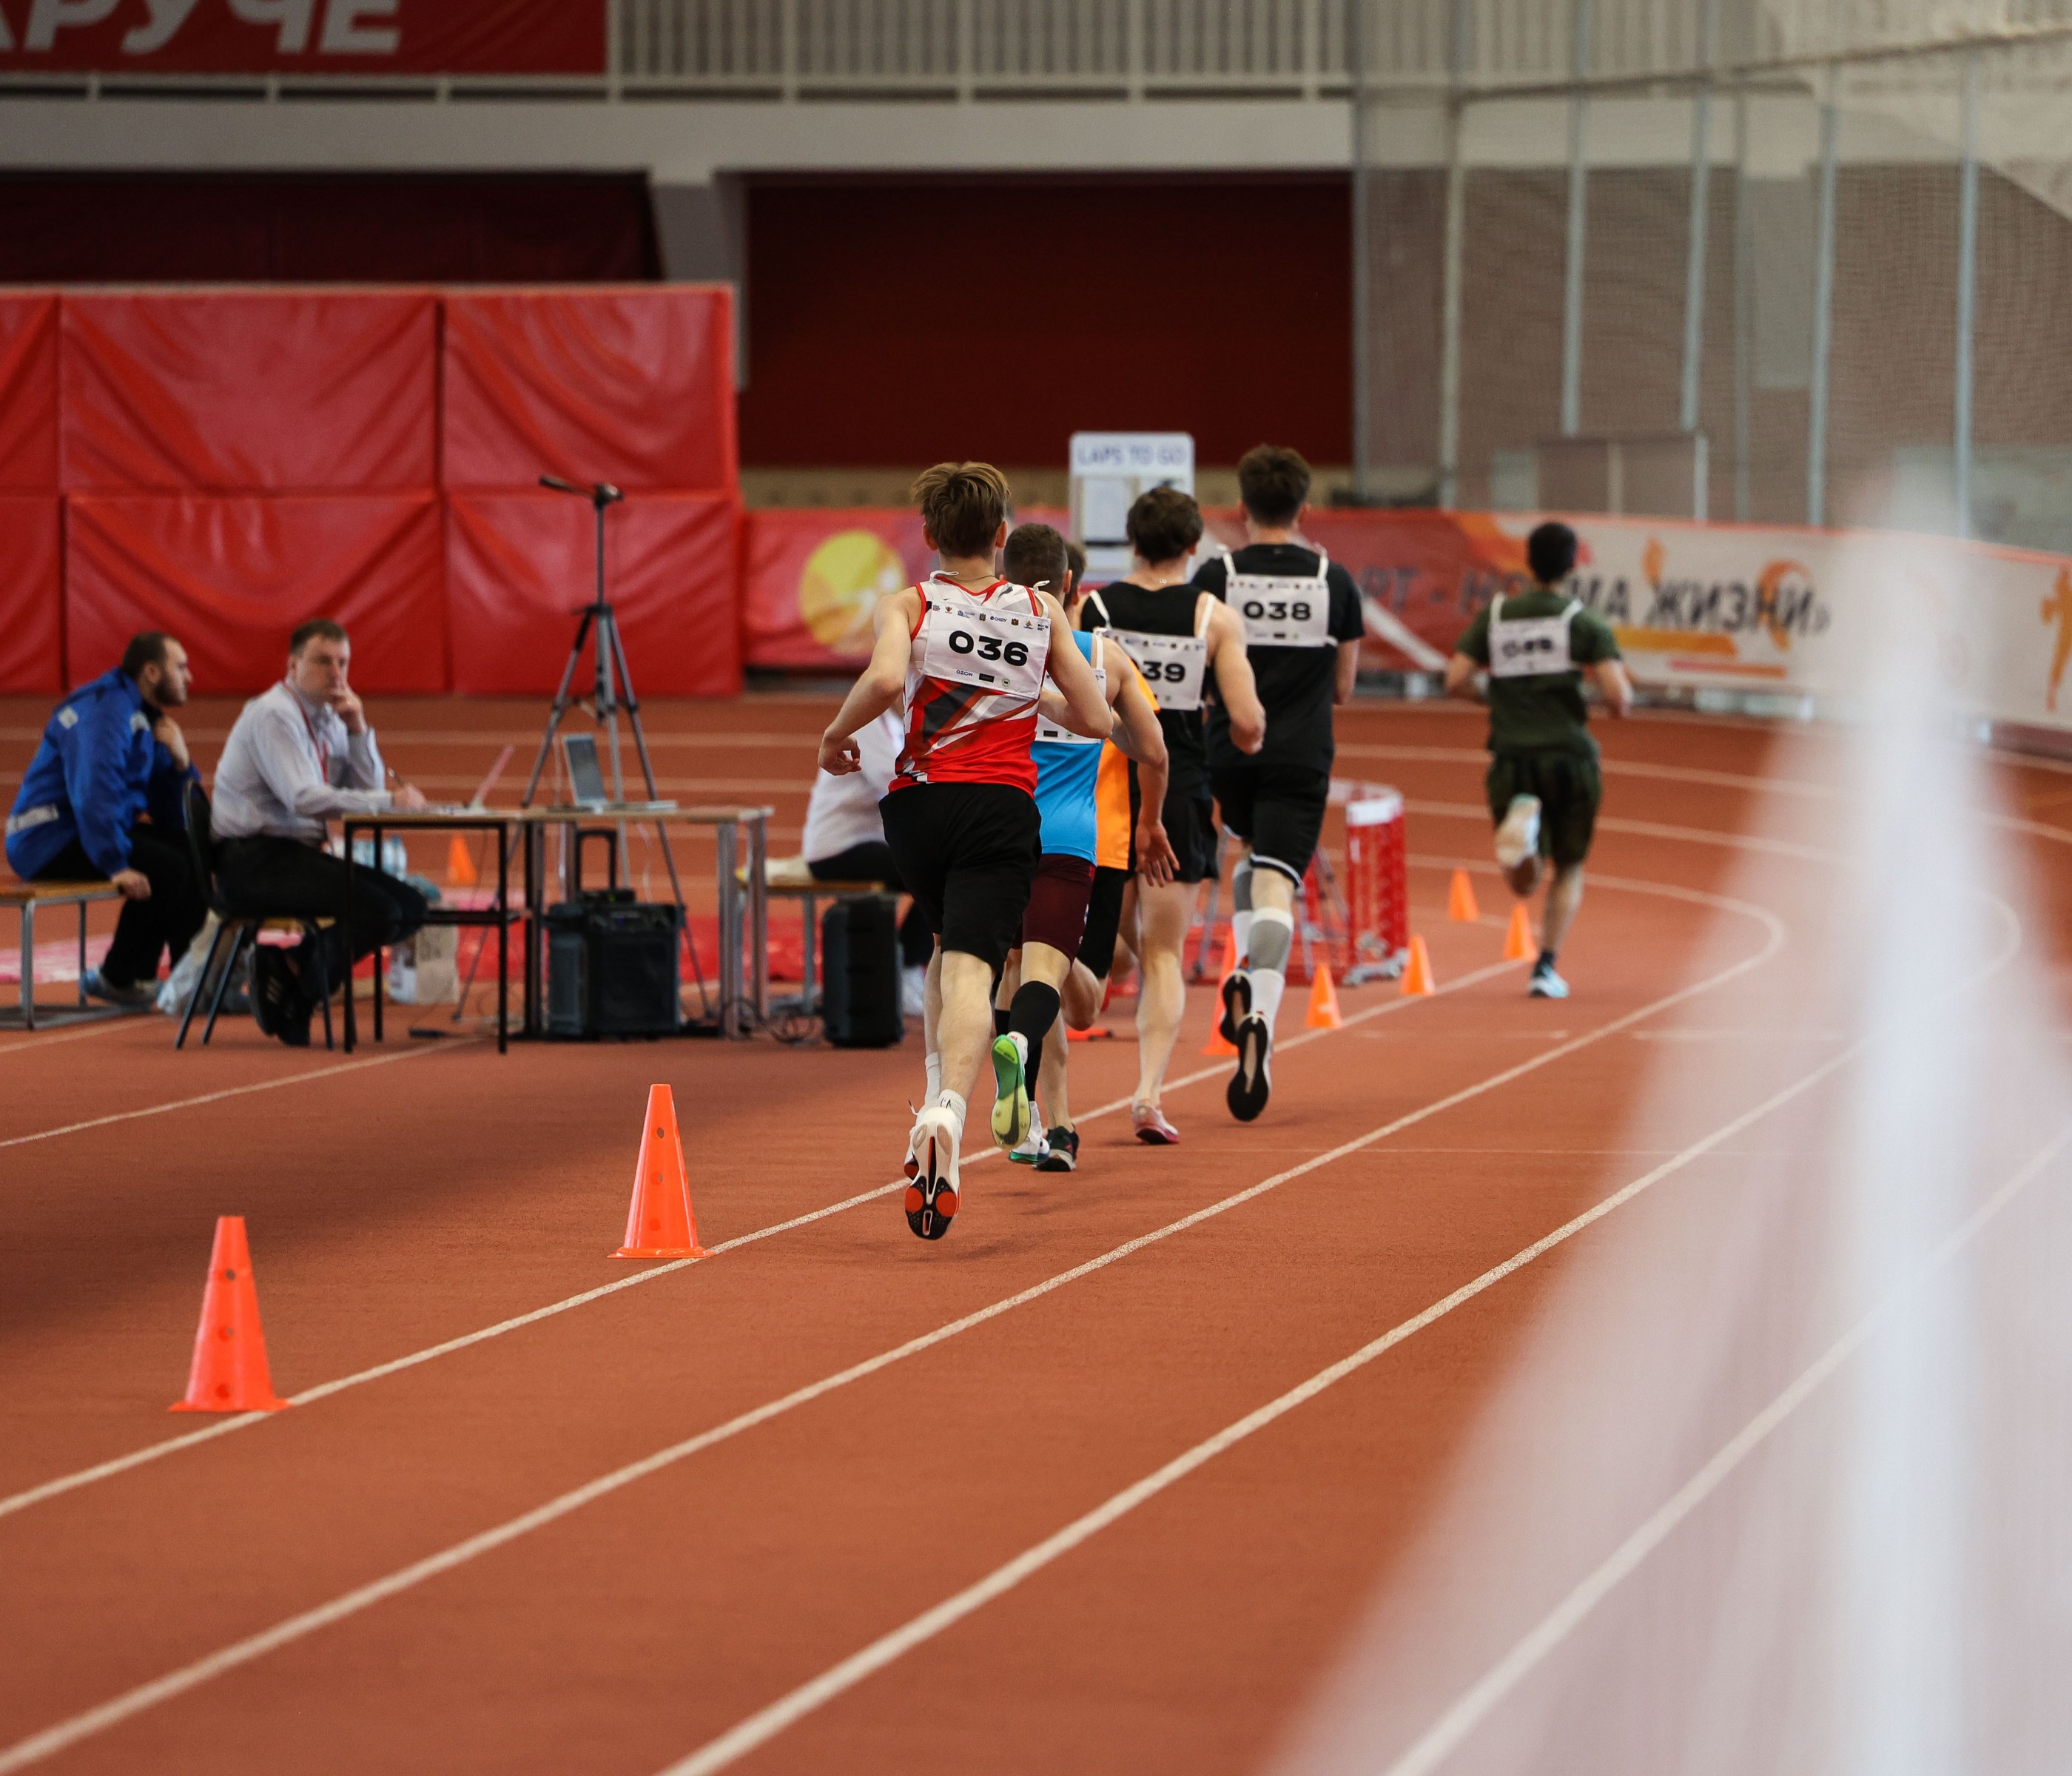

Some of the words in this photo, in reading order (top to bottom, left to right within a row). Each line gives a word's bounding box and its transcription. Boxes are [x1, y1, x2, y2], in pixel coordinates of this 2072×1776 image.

[0, 0, 400, 54] РУЧЕ
[1077, 445, 1123, 465] LAPS
[1129, 445, 1154, 465] TO
[1157, 445, 1185, 465] GO
[1243, 601, 1311, 621] 038
[949, 630, 1029, 666] 036
[1129, 656, 1185, 682] 39
